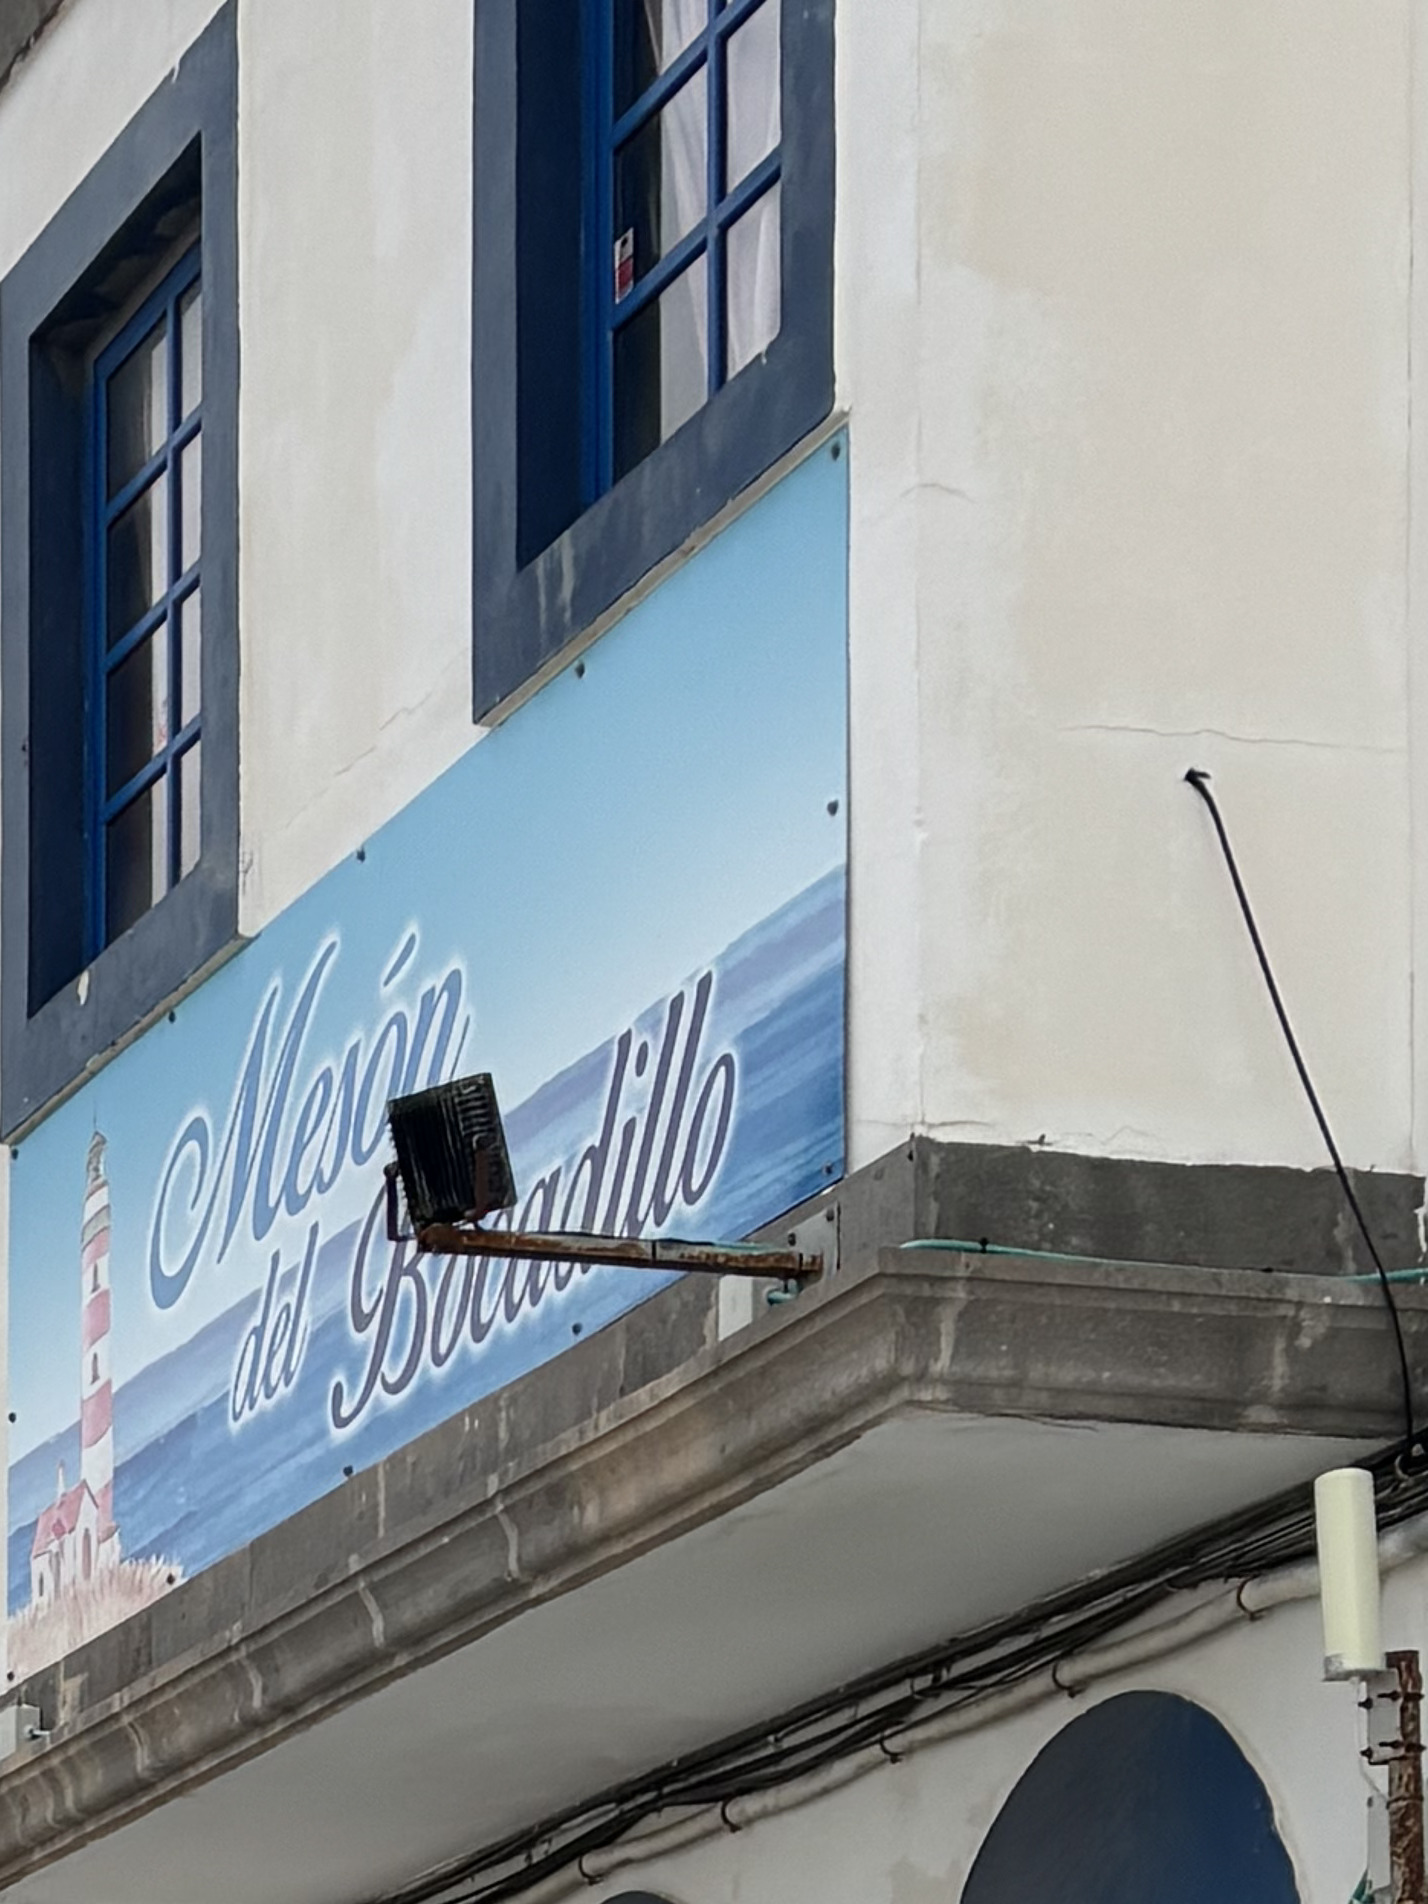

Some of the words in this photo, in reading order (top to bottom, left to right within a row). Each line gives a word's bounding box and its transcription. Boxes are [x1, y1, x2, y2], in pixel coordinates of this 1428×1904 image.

[150, 931, 471, 1310] Mesón
[232, 1221, 320, 1423] del
[332, 970, 735, 1430] Bocadillo
